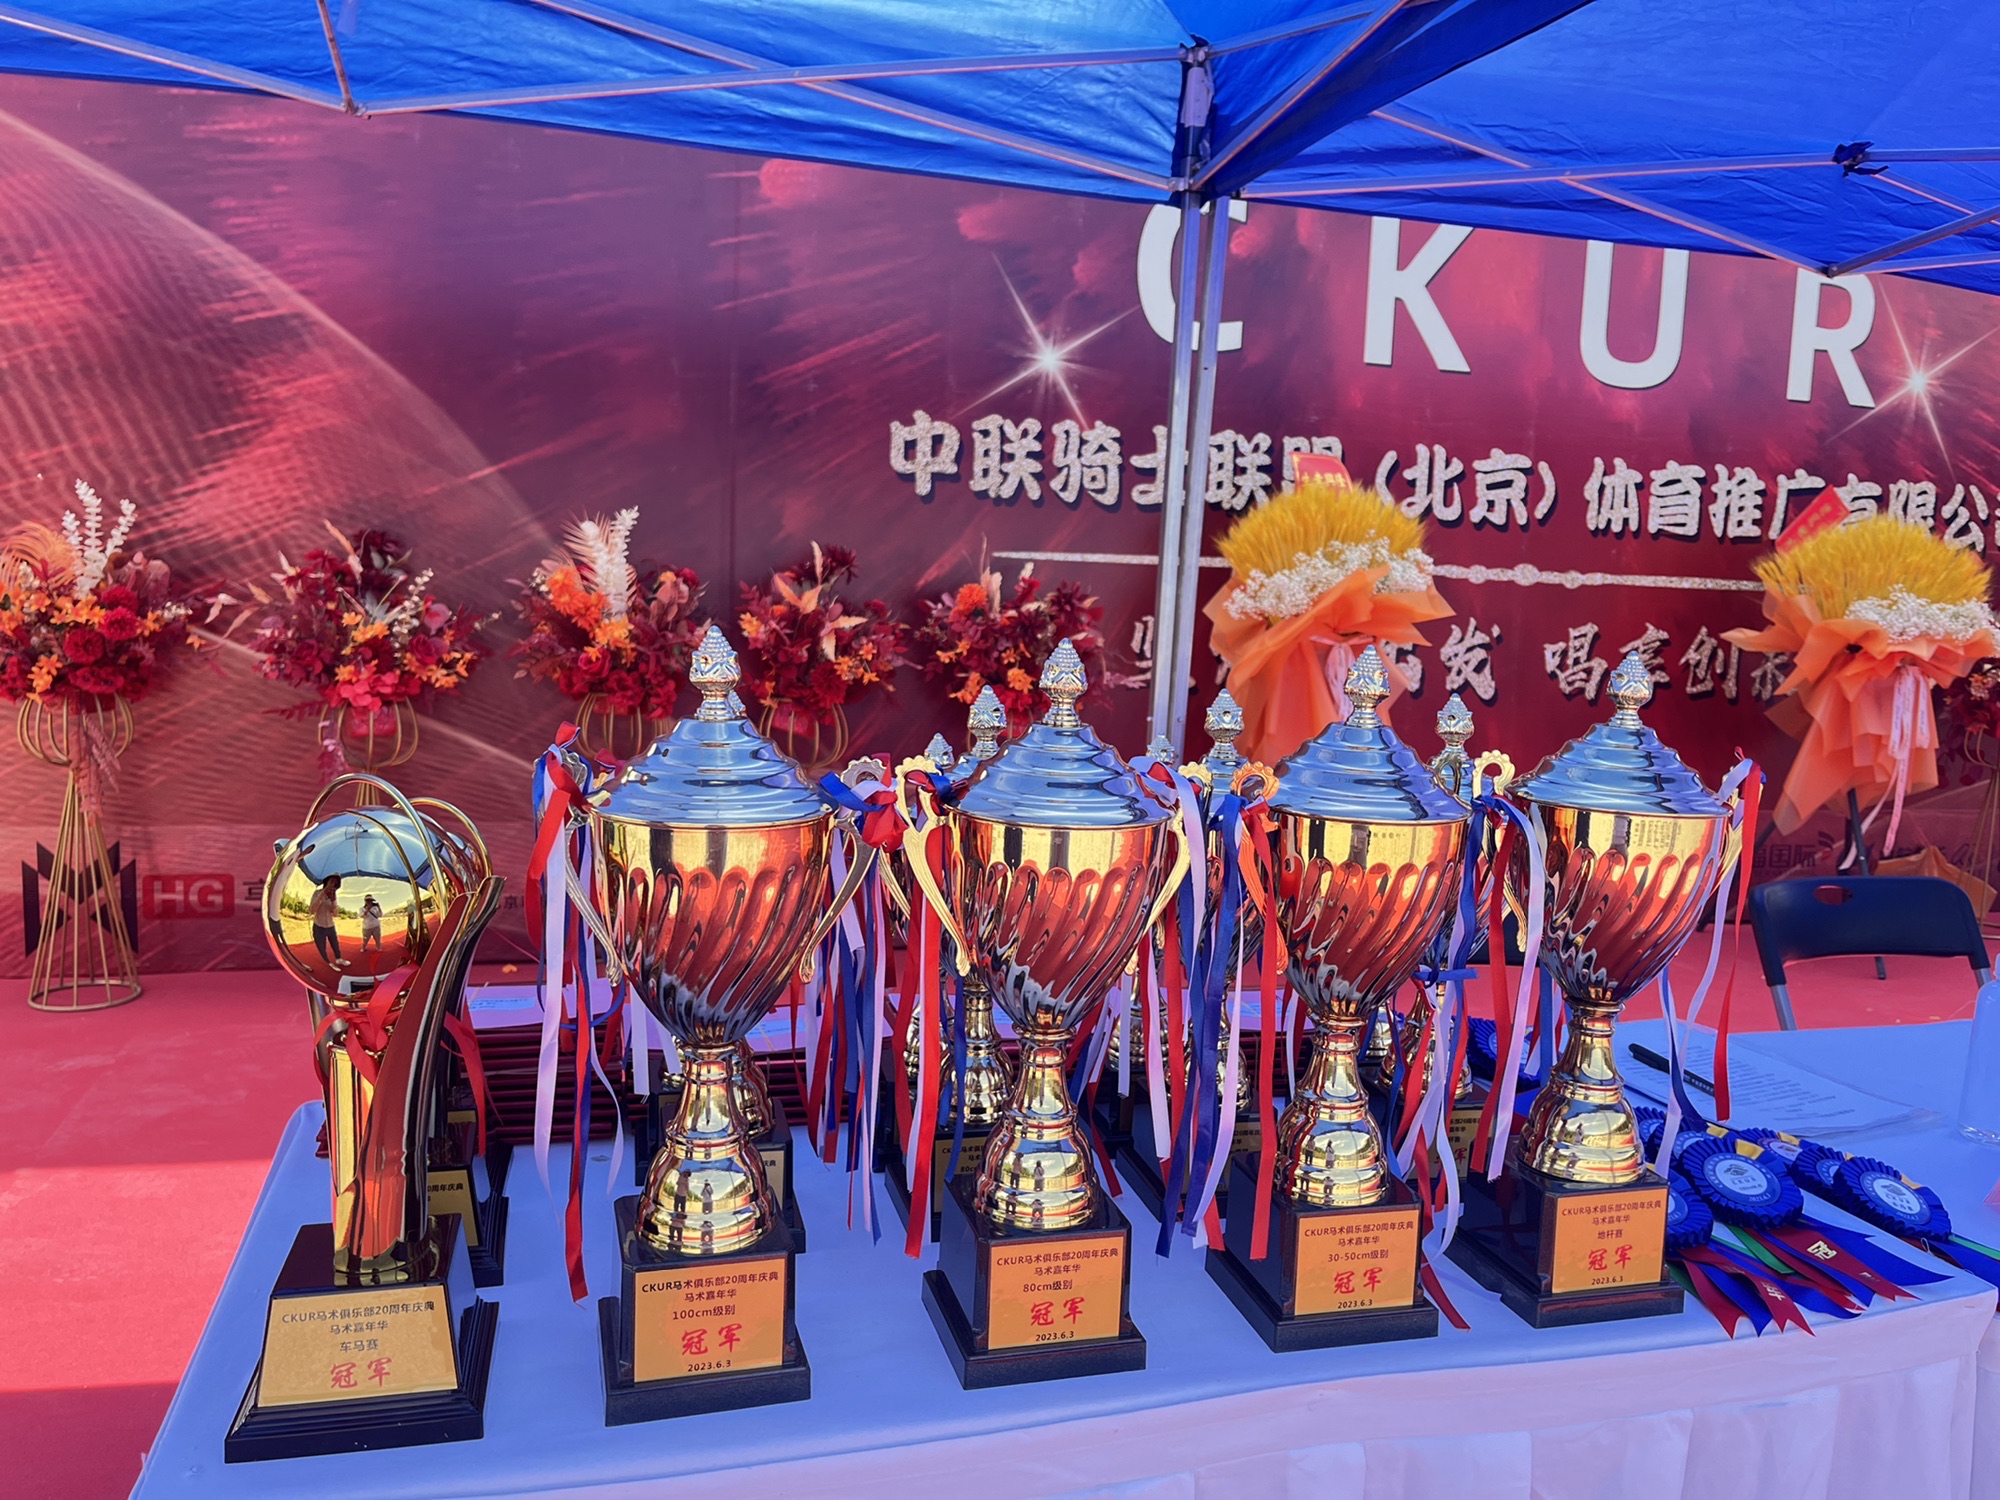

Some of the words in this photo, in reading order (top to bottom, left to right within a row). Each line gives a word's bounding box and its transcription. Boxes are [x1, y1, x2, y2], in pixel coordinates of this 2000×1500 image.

[153, 880, 223, 914] HG
[1304, 1221, 1414, 1237] CKUR马术俱乐部20周年庆典
[1338, 1236, 1380, 1247] 马术嘉年华
[997, 1248, 1118, 1266] CKUR马术俱乐部20周年庆典
[1328, 1249, 1389, 1262] 30-50cm级别
[1588, 1244, 1632, 1271] 冠军
[1034, 1264, 1081, 1276] 马术嘉年华
[641, 1271, 779, 1293] CKUR马术俱乐部20周年庆典
[1023, 1280, 1073, 1293] 80cm级别
[1333, 1267, 1383, 1294] 冠军
[1591, 1276, 1623, 1285] 2023.6.3
[684, 1288, 737, 1303] 马术嘉年华
[1030, 1297, 1085, 1326] 冠军
[1338, 1299, 1373, 1309] 2023.6.3
[282, 1301, 435, 1323] CKUR马术俱乐部20周年庆典
[672, 1304, 736, 1320] 100cm级别
[329, 1320, 389, 1334] 马术嘉年华
[681, 1323, 742, 1356] 冠军
[1035, 1331, 1074, 1342] 2023.6.3
[339, 1339, 379, 1352] 车马赛
[329, 1357, 393, 1389] 冠军
[688, 1359, 731, 1372] 2023.6.3
